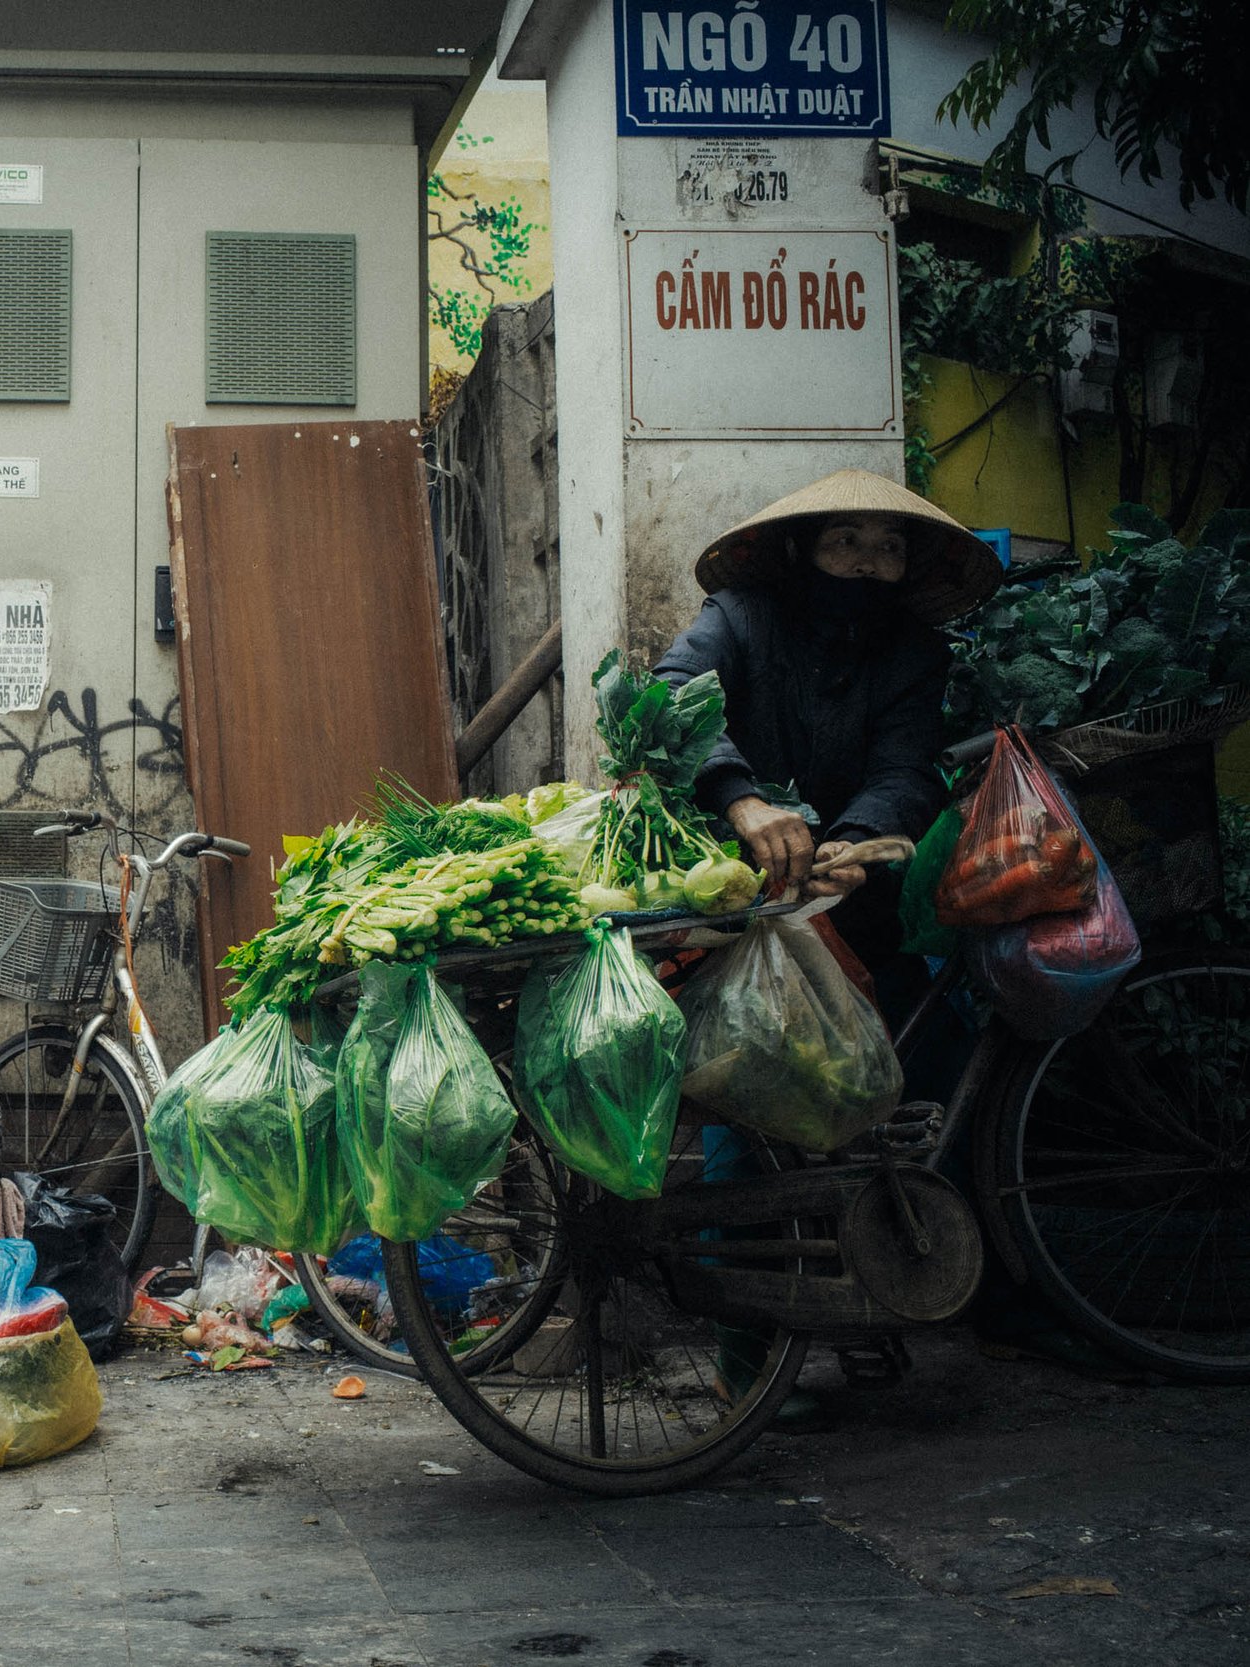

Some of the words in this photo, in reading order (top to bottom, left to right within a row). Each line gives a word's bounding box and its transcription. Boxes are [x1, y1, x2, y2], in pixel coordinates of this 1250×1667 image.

[642, 1, 767, 72] NGÕ
[790, 14, 863, 73] 40
[644, 78, 713, 113] TRẦN
[722, 83, 790, 119] NHẬT
[798, 84, 864, 121] DUẬT
[656, 249, 732, 330] CẤM
[742, 247, 788, 330] ĐỔ
[799, 258, 866, 330] RÁC
[6, 600, 45, 629] NHÀ
[14, 684, 41, 707] 3456
